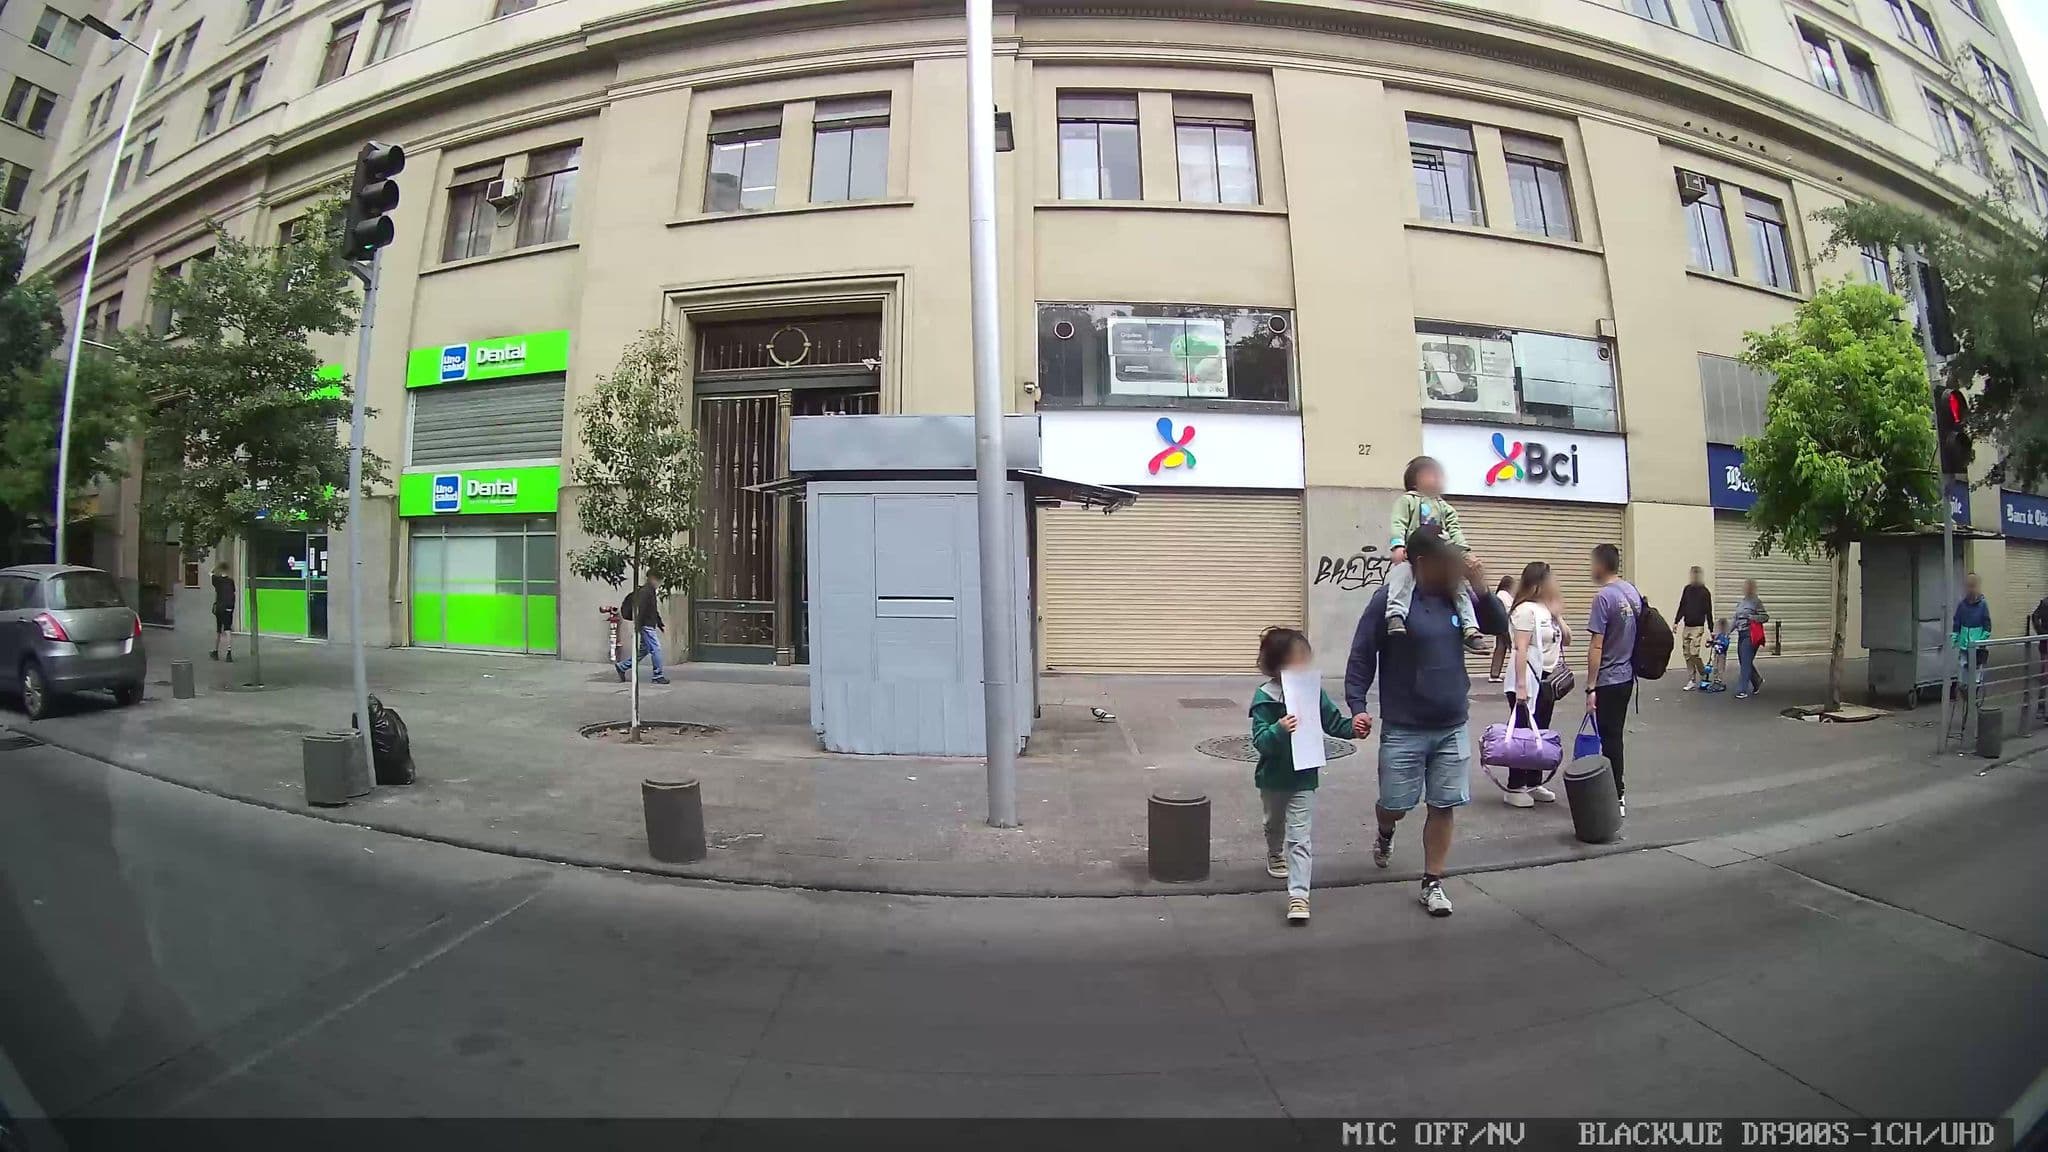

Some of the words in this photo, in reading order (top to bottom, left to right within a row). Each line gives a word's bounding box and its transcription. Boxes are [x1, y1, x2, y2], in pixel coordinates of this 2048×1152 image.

[477, 342, 526, 364] Dental
[1358, 444, 1372, 456] 27
[1524, 442, 1579, 486] Bci
[466, 478, 518, 497] Dental
